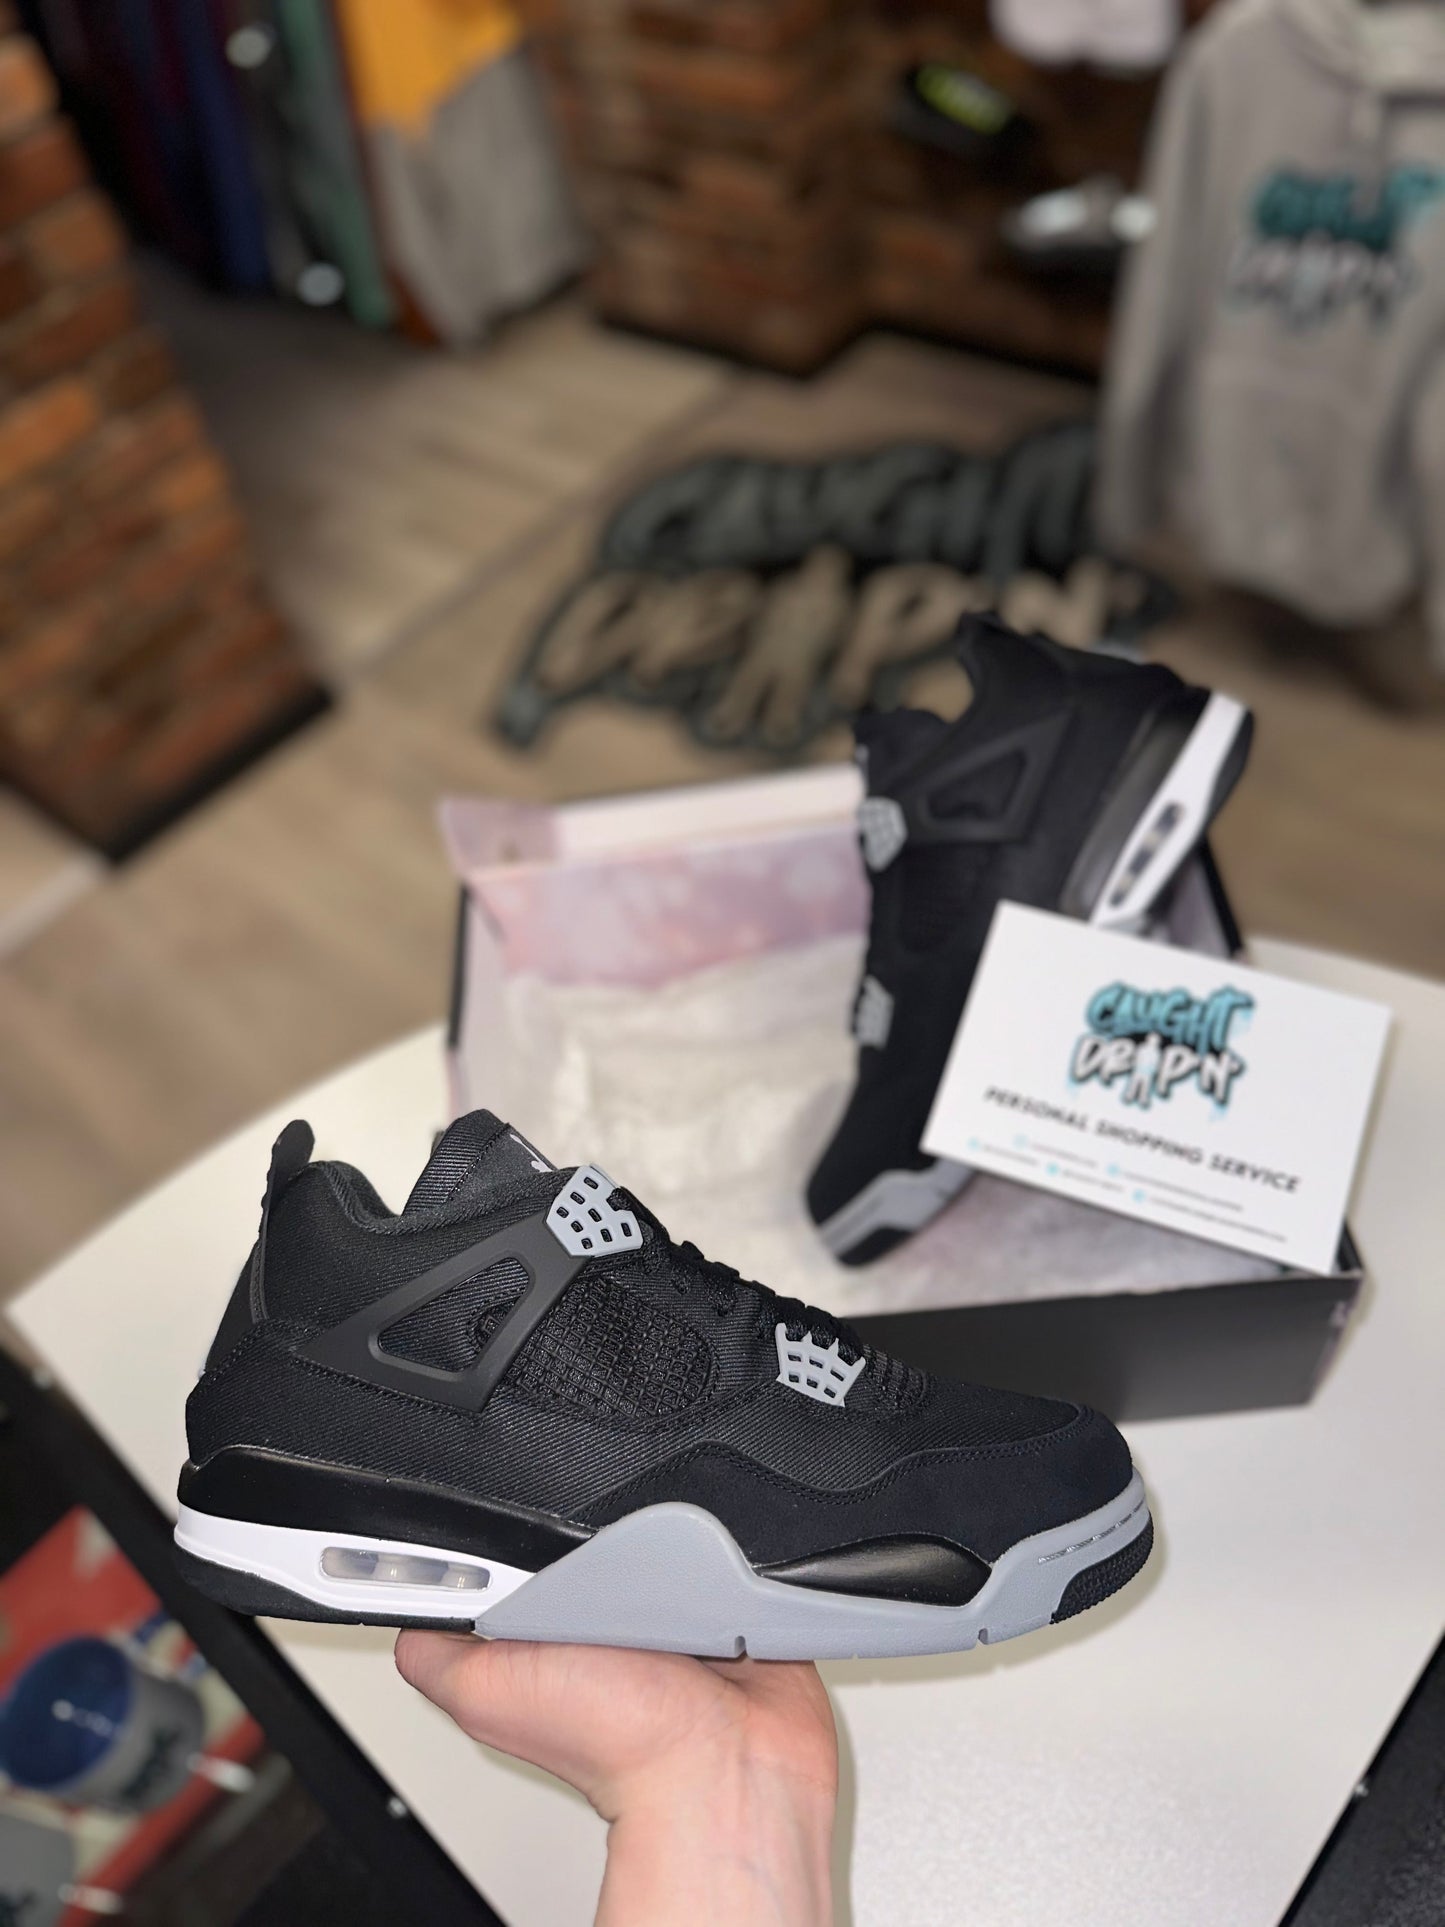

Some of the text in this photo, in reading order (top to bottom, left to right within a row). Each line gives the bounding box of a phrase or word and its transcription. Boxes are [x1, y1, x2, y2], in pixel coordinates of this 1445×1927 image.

[1086, 983, 1255, 1052] CAUGHT
[984, 1086, 1088, 1131] PERSONAL
[1095, 1119, 1203, 1165] SHOPPING
[1209, 1153, 1300, 1193] SERVICE
